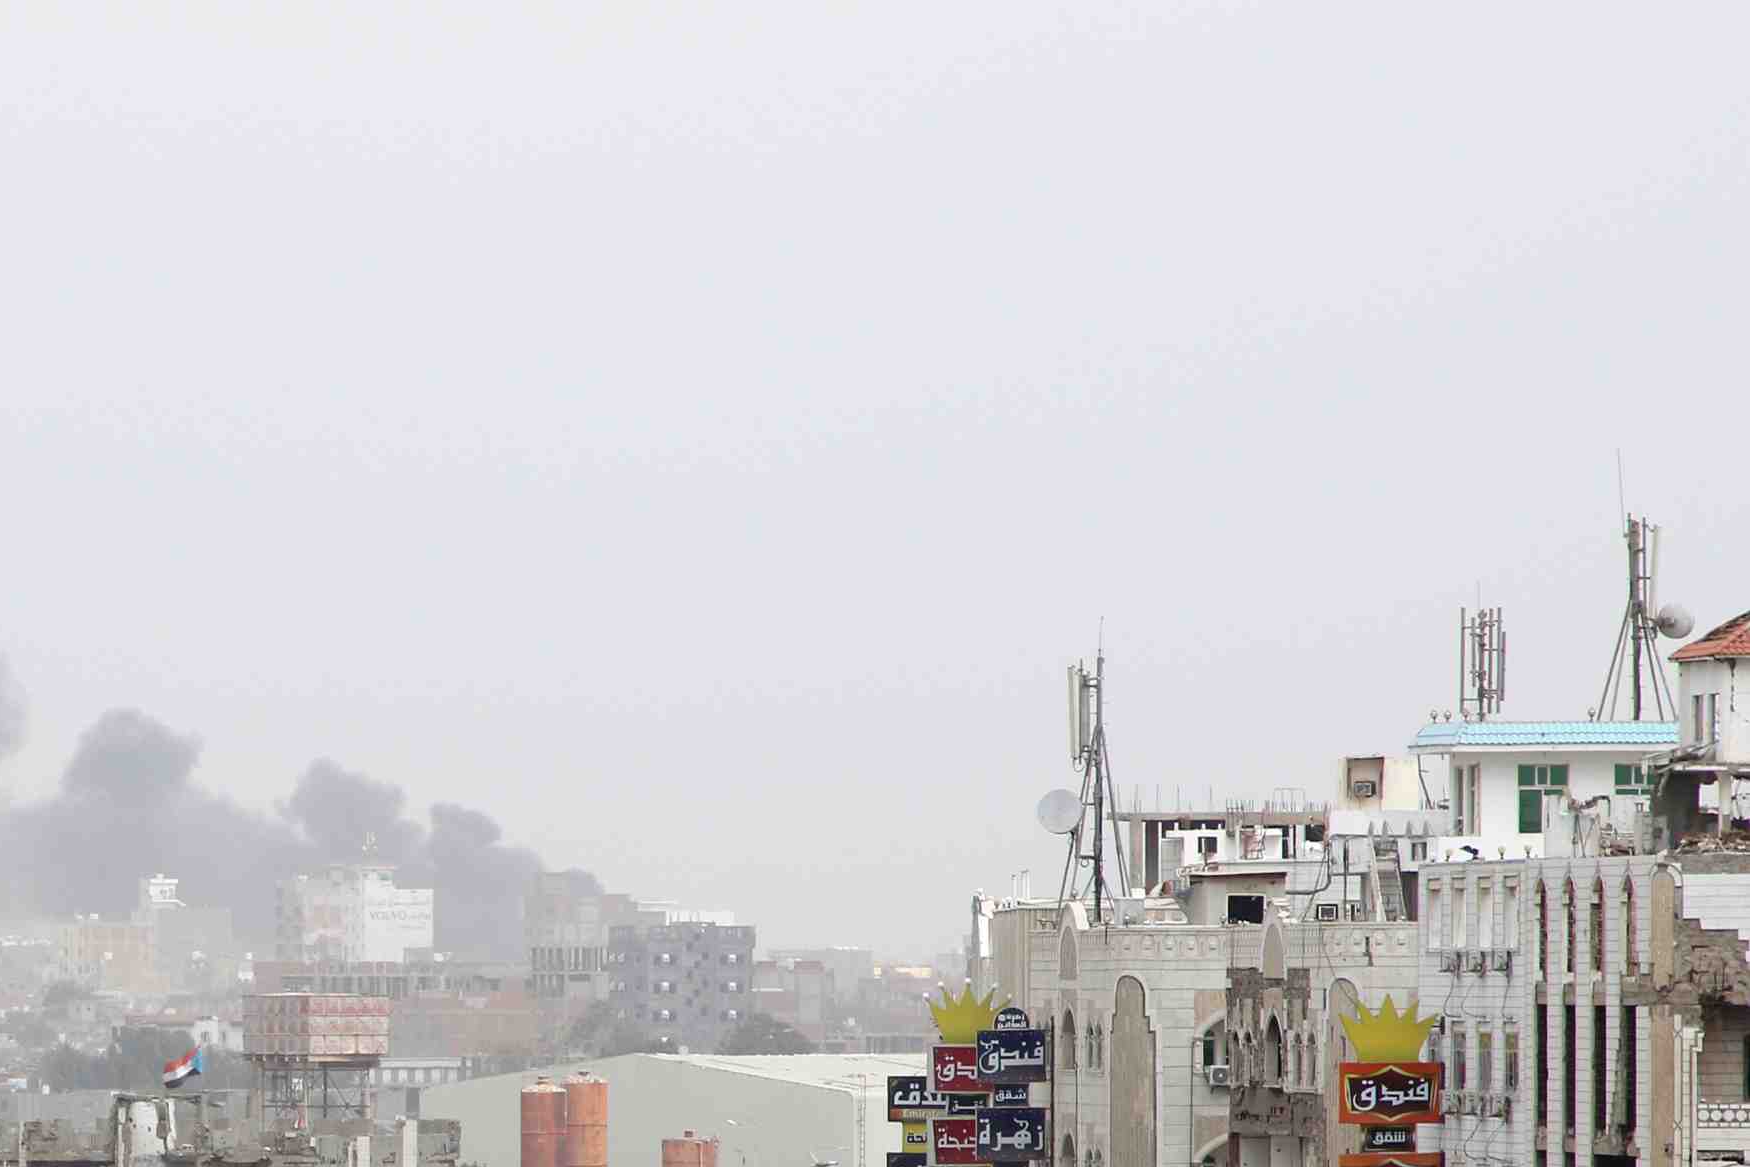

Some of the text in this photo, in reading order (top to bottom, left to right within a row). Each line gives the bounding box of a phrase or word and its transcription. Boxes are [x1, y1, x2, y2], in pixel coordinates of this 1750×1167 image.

[978, 1039, 1044, 1074] فندق
[1352, 1077, 1430, 1112] فندق
[978, 1117, 1044, 1151] زهرة
